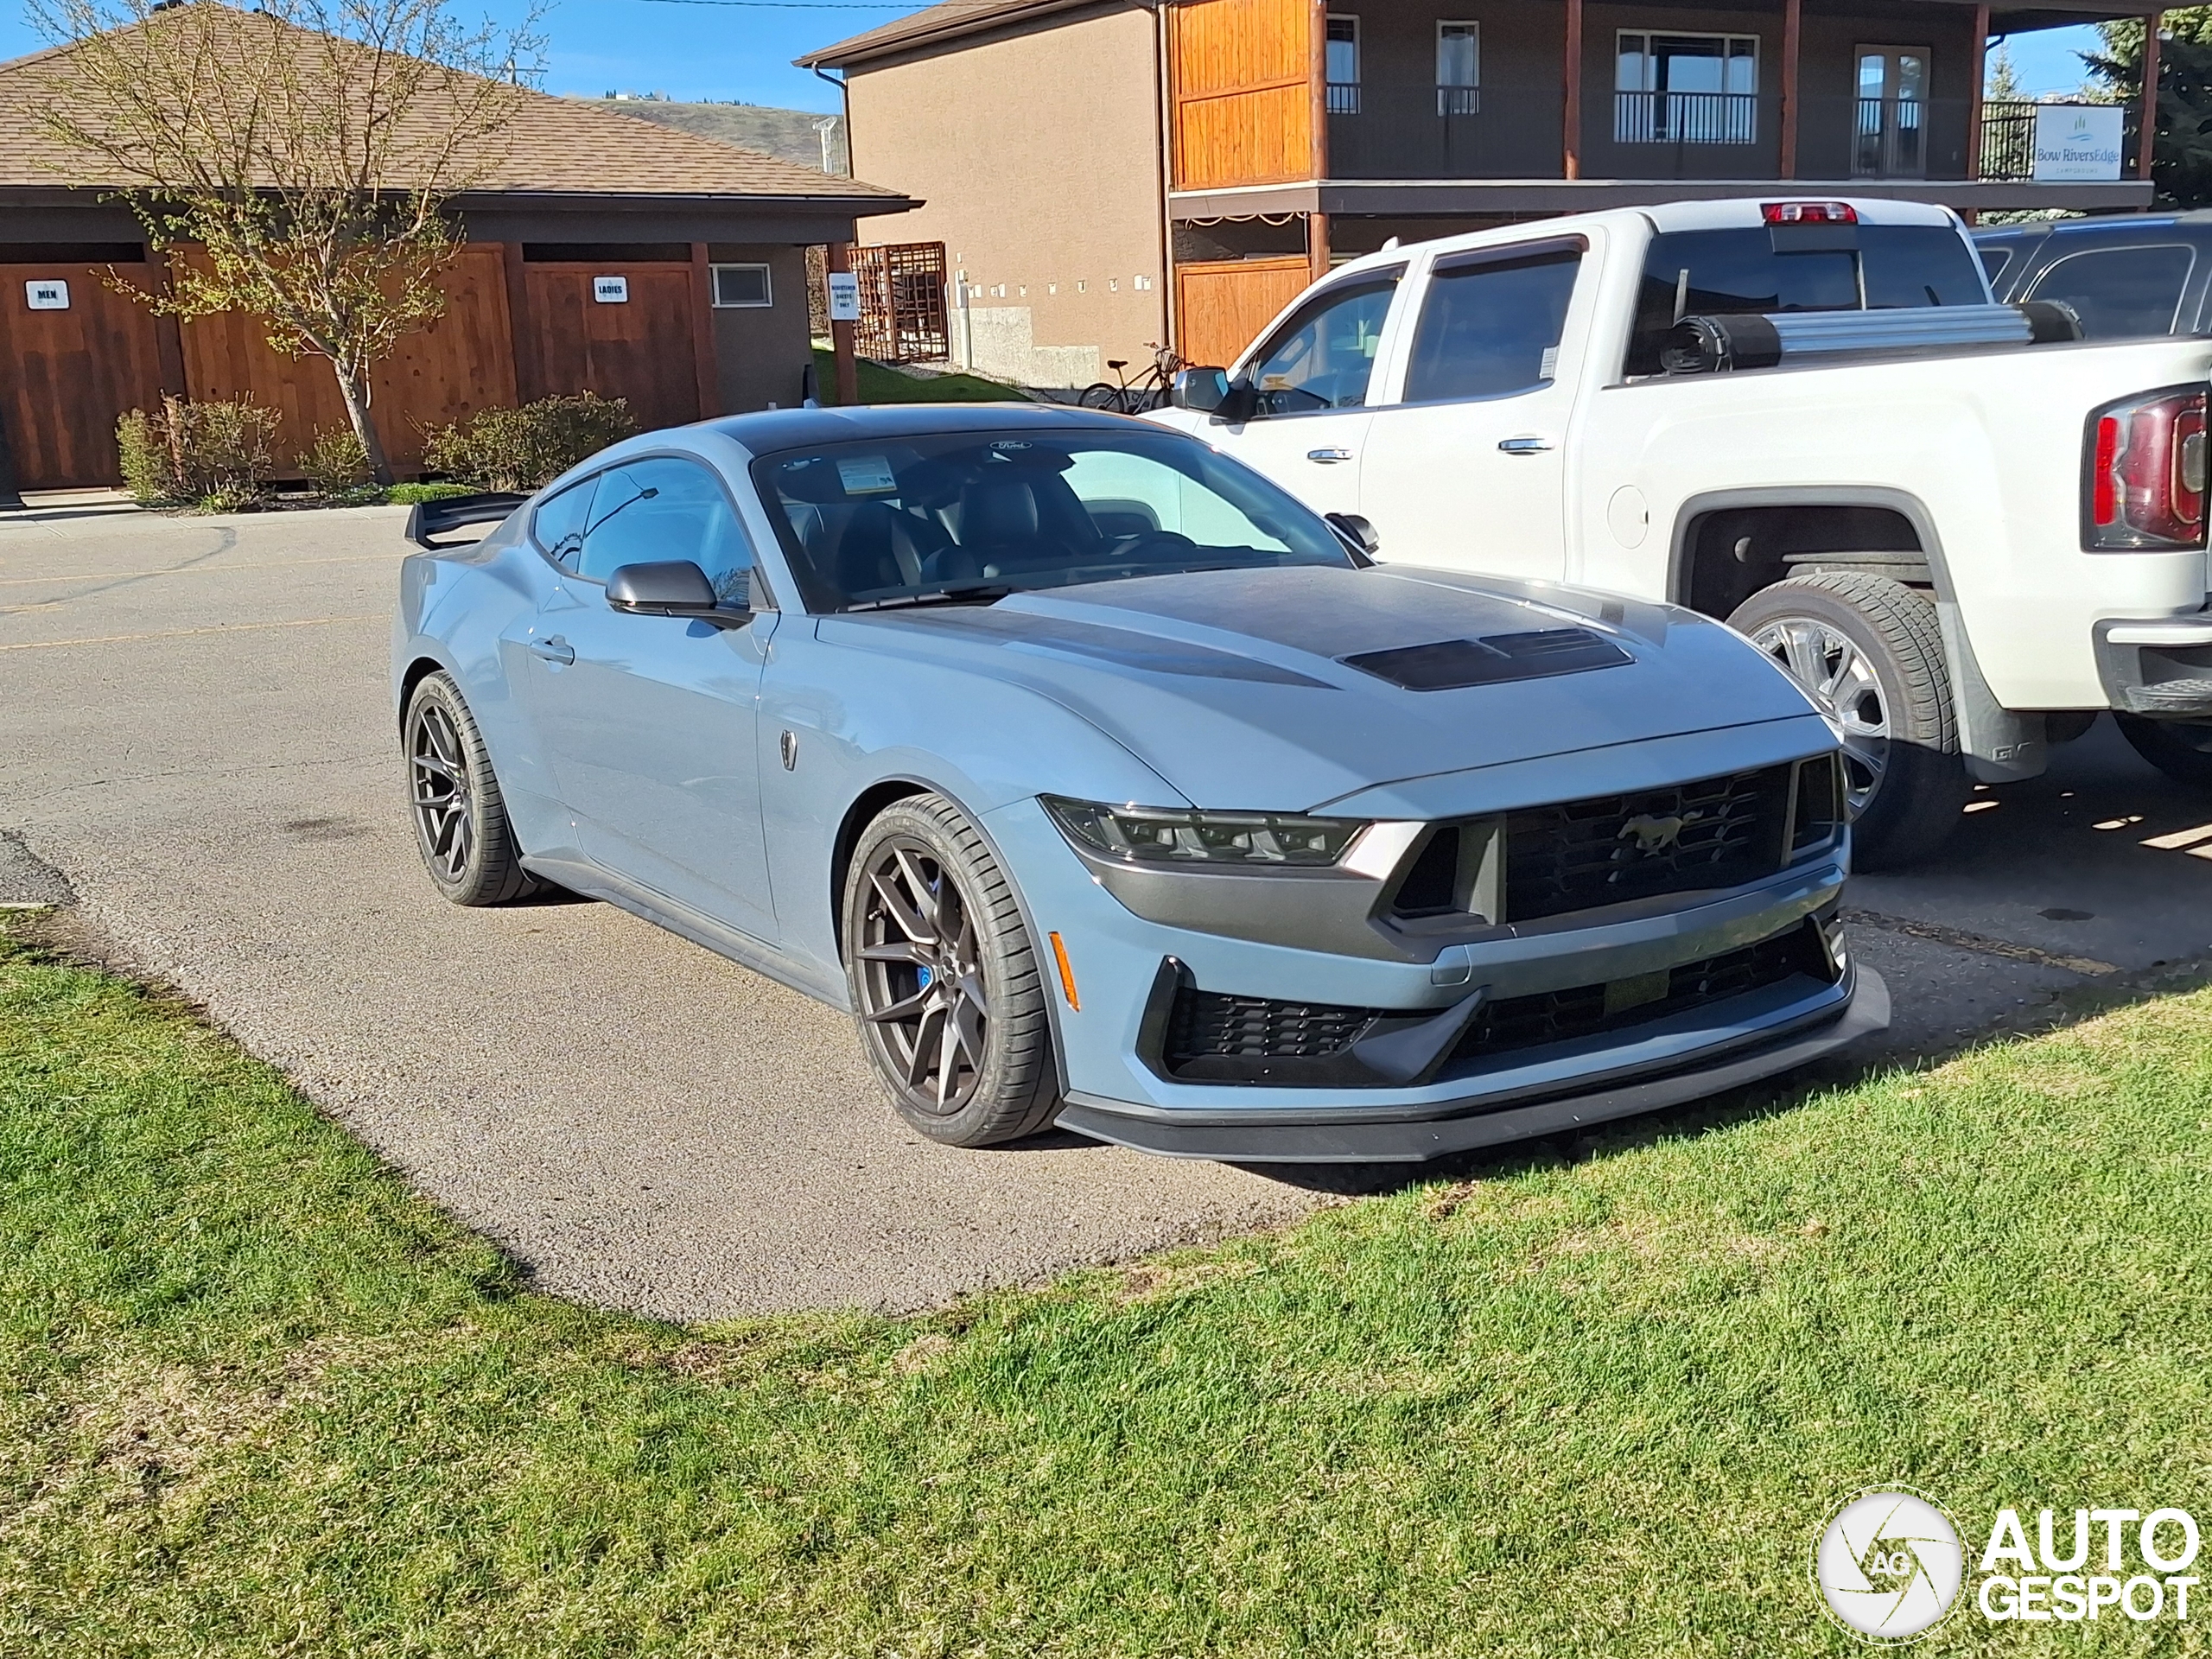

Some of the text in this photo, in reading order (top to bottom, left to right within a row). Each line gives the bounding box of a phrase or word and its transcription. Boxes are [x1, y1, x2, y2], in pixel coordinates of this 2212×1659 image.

[2037, 148, 2120, 164] Bow RiversEdge
[38, 289, 56, 299] MEN
[599, 285, 622, 295] LADIES
